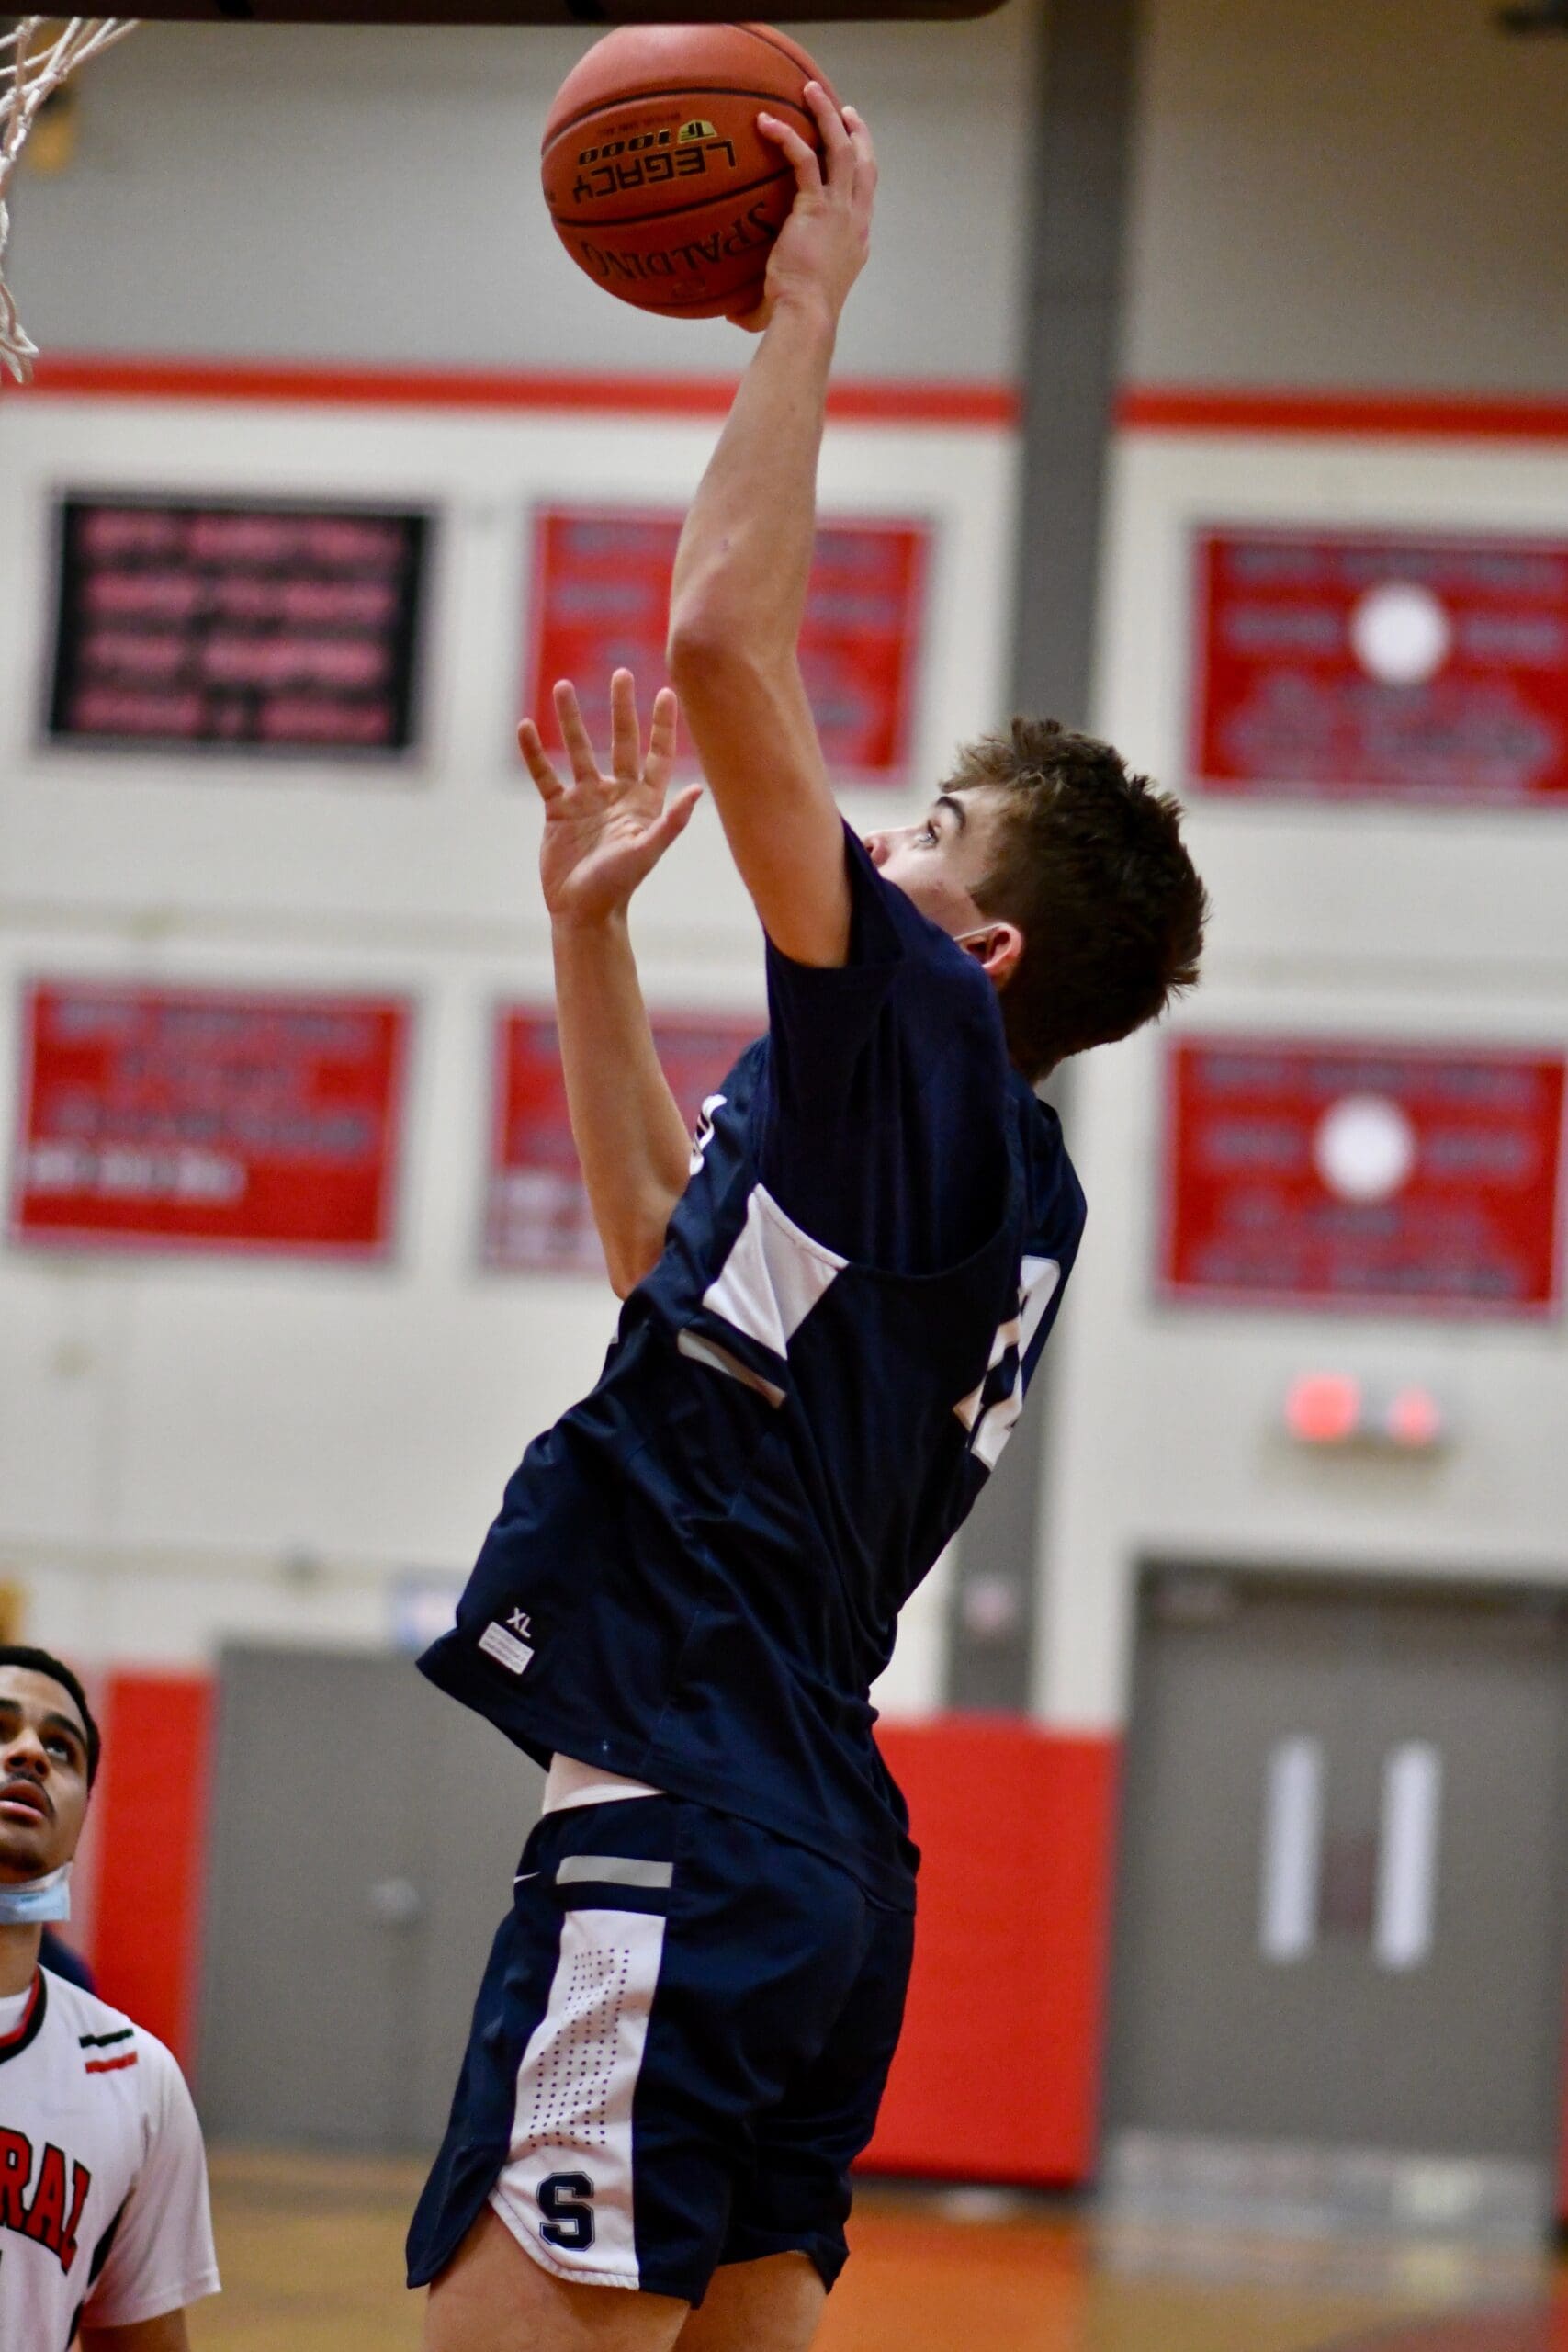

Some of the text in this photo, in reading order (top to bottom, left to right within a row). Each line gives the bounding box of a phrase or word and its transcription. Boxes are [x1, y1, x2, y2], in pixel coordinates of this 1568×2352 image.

[572, 139, 737, 204] LEGACY
[578, 129, 671, 165] 1000
[581, 200, 778, 280] SPALDING
[506, 1606, 531, 1638] XL
[536, 2170, 596, 2253] S
